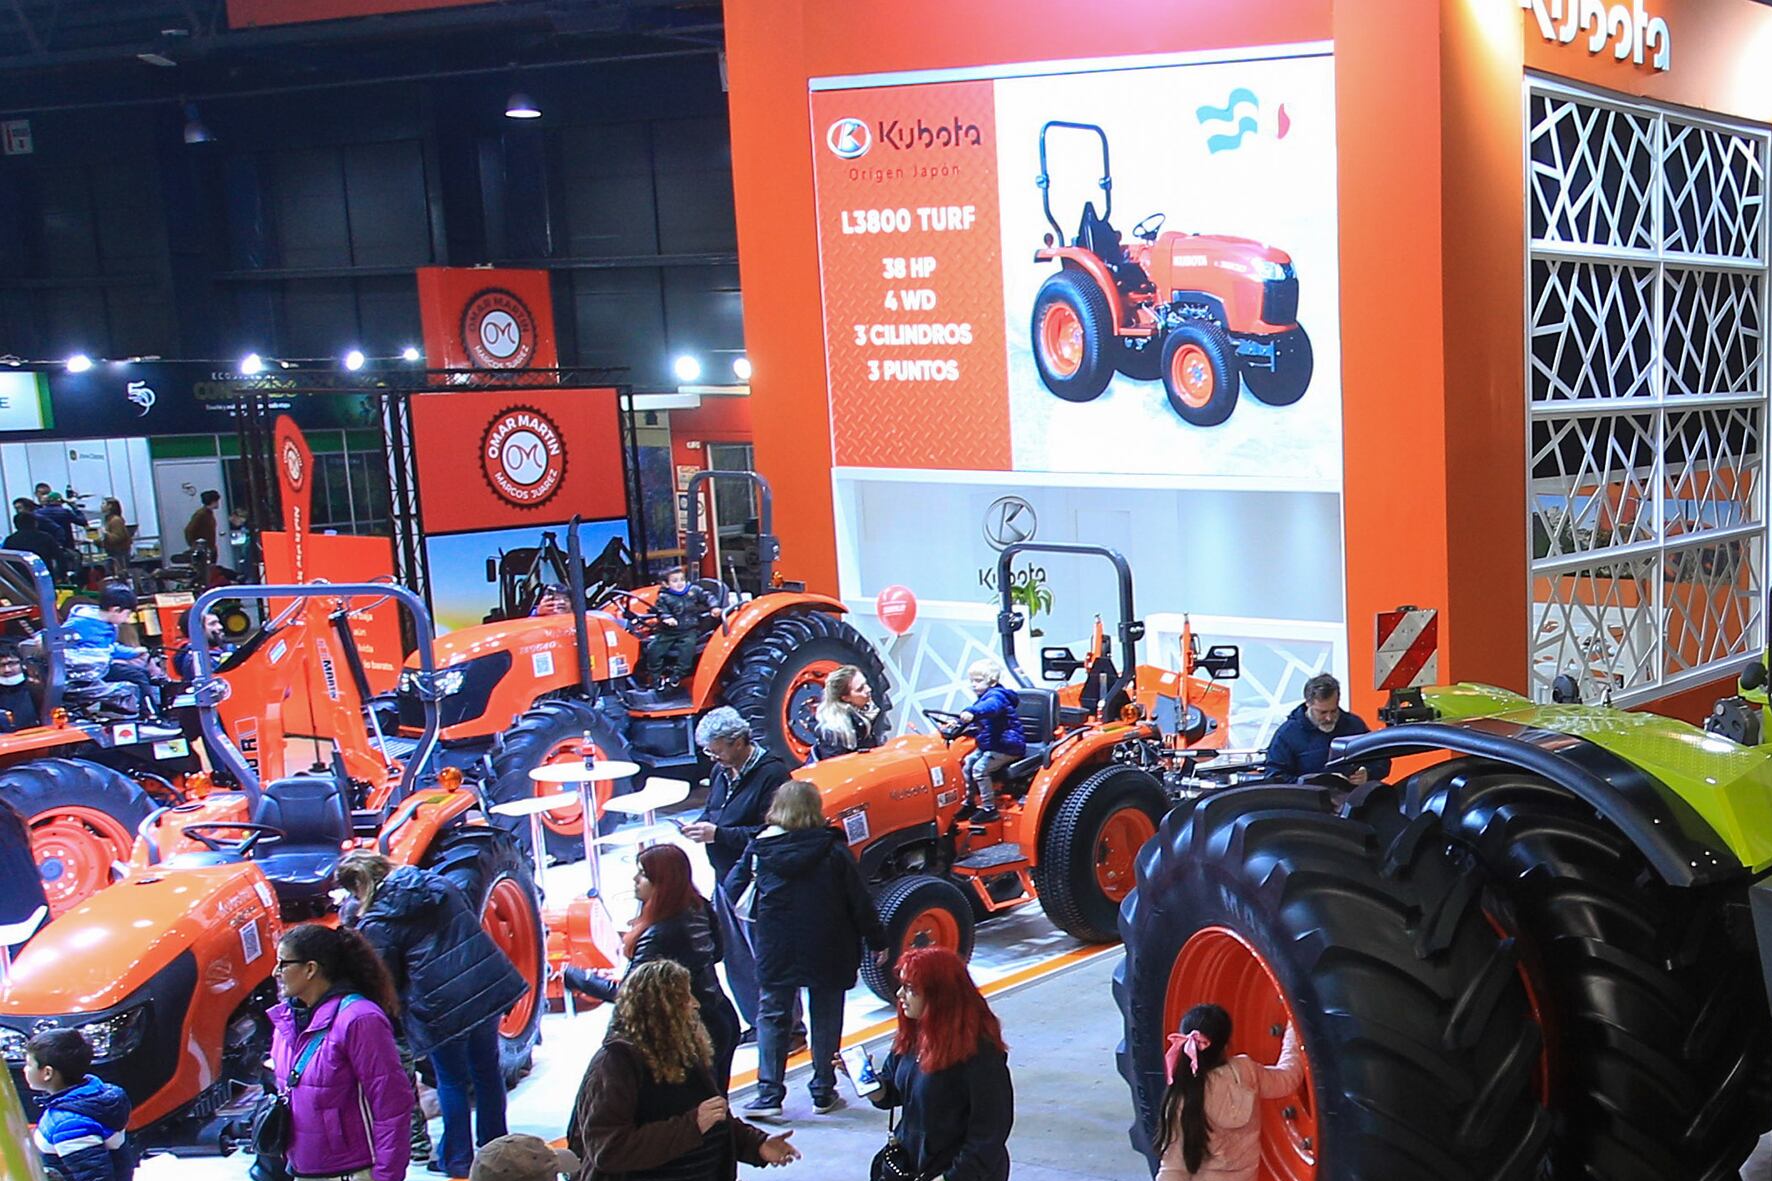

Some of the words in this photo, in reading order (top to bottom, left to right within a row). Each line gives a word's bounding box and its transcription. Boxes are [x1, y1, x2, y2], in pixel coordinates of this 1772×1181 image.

[878, 117, 982, 150] Kubota
[850, 168, 903, 183] Origen
[913, 163, 961, 179] Japón
[841, 209, 911, 235] L3800
[917, 206, 976, 231] TURF
[882, 257, 907, 279] 38
[910, 256, 937, 278] HP
[884, 290, 898, 311] 4
[900, 289, 937, 310] WD
[854, 324, 868, 346] 3
[869, 323, 973, 346] CILINDROS
[867, 360, 880, 382] 3
[883, 359, 960, 382] PUNTOS
[488, 417, 517, 459] OMAR
[517, 414, 560, 456] MARTIN
[494, 471, 529, 500] MARCOS
[979, 562, 1047, 590] Kota
